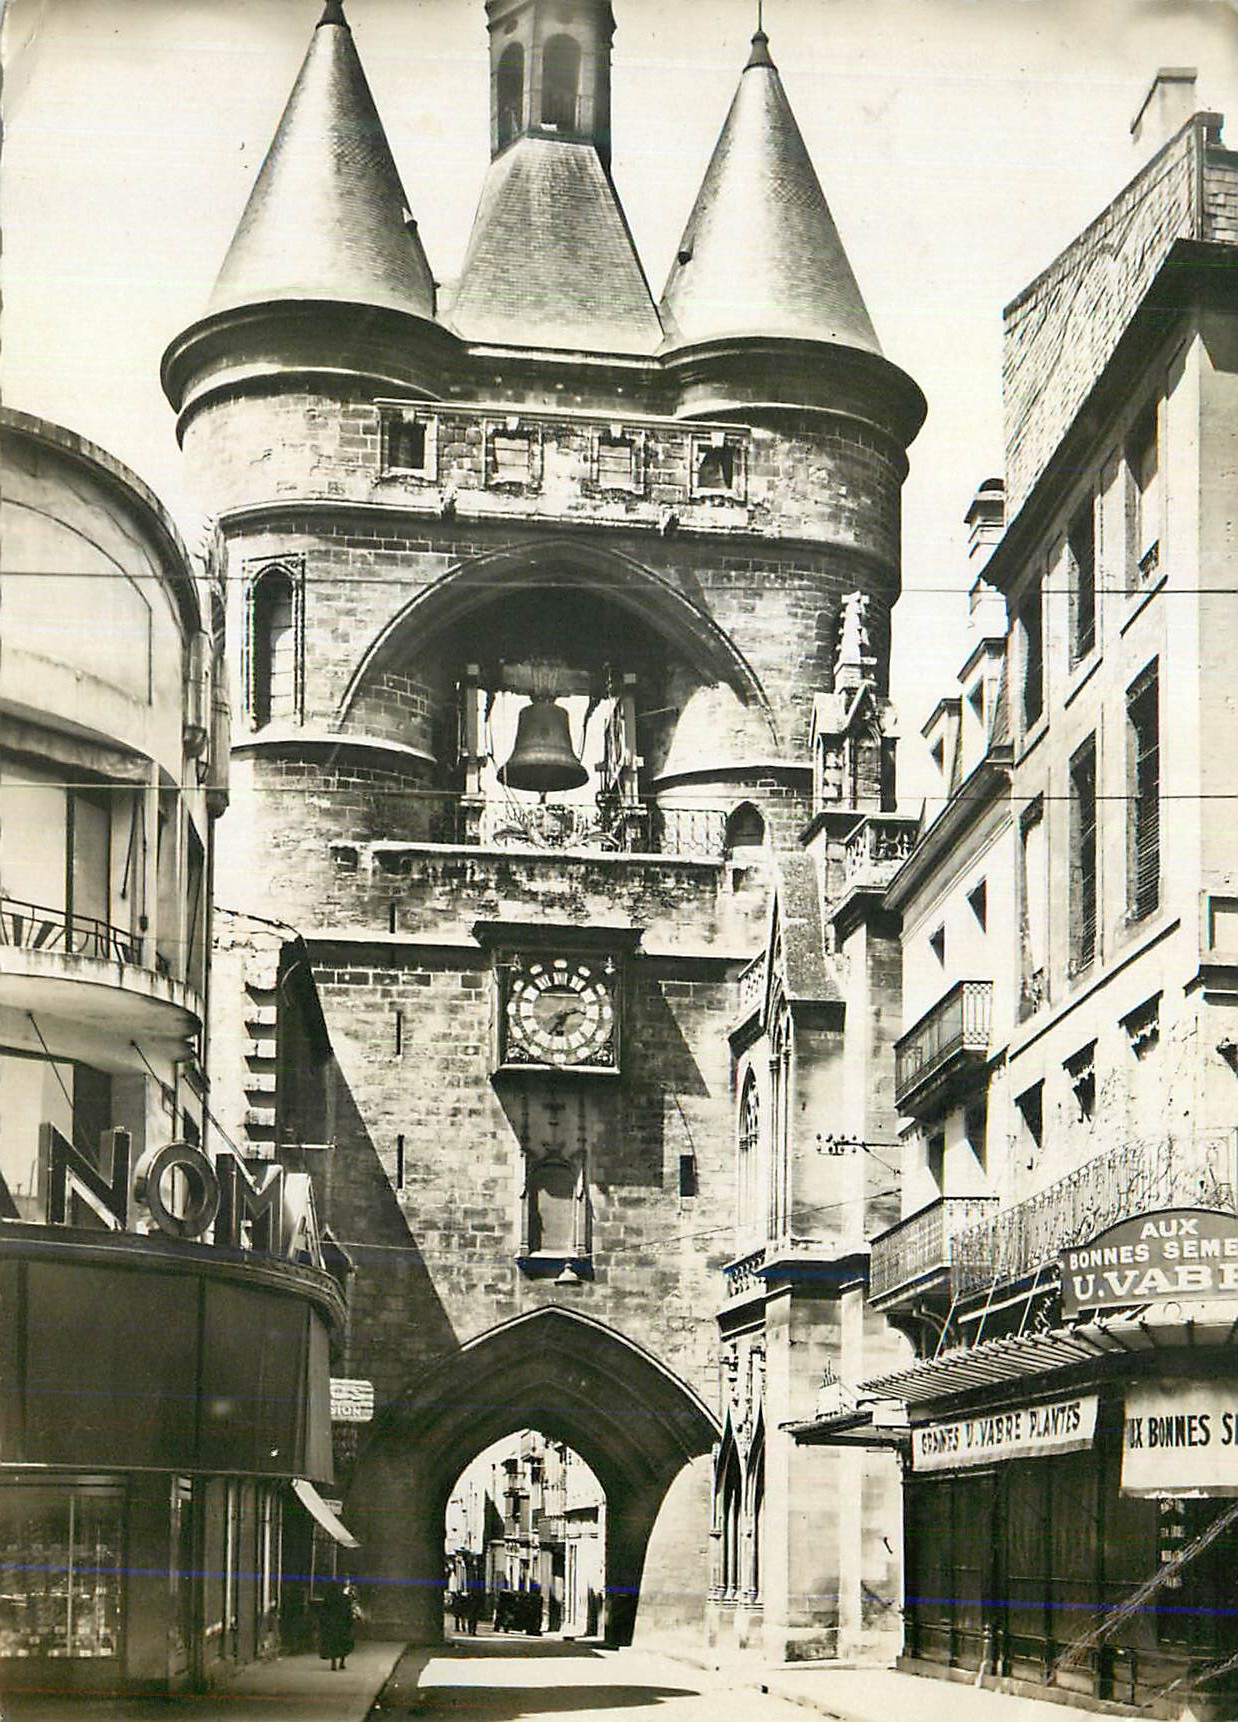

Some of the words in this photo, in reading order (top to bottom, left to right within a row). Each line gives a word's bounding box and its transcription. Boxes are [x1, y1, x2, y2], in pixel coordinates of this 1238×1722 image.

[0, 1120, 326, 1270] NOMA
[1139, 1218, 1198, 1240] AUX
[1069, 1243, 1150, 1271] BONNES
[1029, 1401, 1081, 1438] PLANTES
[1148, 1414, 1211, 1448] BONNES
